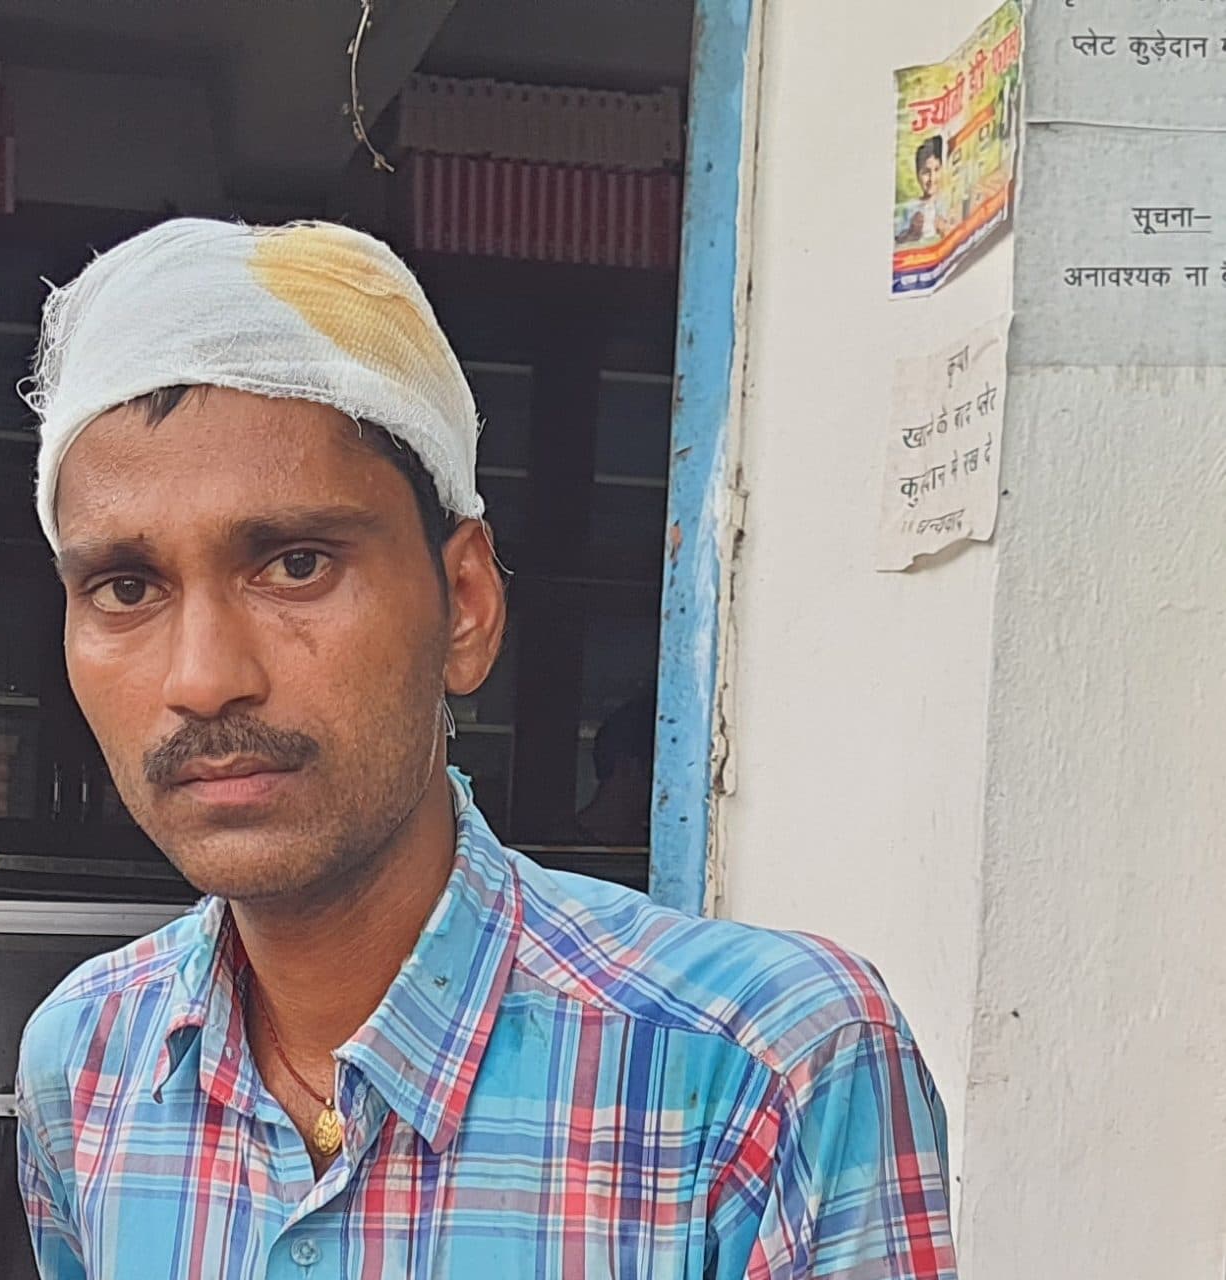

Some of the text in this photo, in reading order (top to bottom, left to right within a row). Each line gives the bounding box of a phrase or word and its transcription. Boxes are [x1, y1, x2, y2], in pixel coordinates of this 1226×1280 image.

[1072, 27, 1116, 56] प्लेट
[1128, 28, 1208, 65] कुड़ेदान
[1064, 267, 1172, 287] अनावश्यक
[1184, 267, 1208, 287] ना
